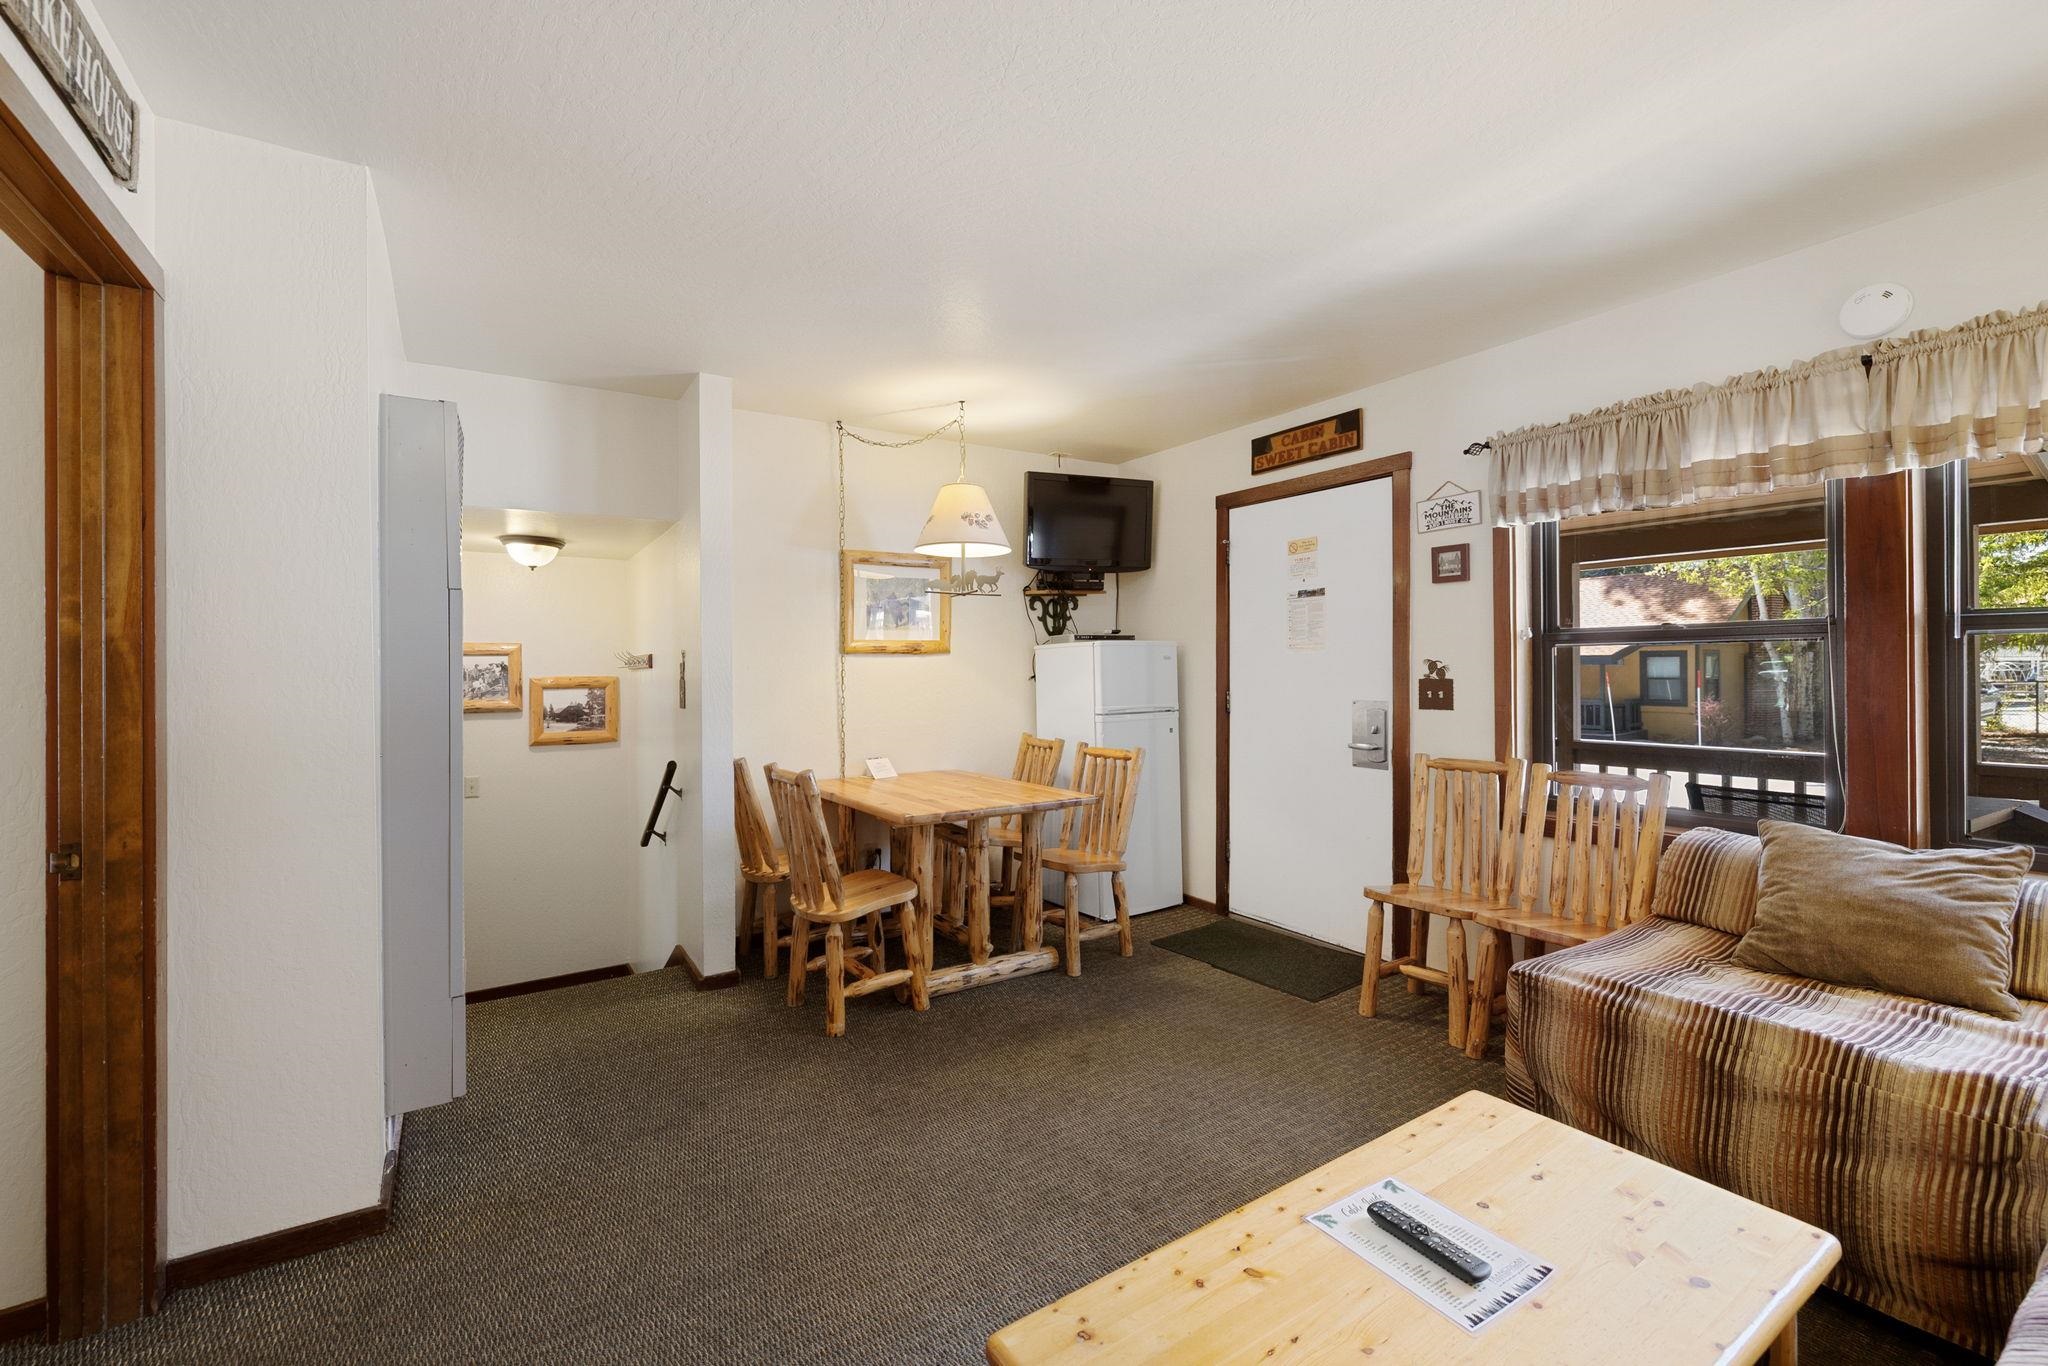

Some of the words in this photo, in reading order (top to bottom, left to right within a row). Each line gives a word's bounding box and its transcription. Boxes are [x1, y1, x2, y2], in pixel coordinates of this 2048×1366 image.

[22, 0, 72, 70] KE
[75, 28, 132, 167] HOUSE
[1281, 425, 1324, 447] CABIN
[1255, 445, 1305, 469] SWEET
[1308, 432, 1354, 455] CABIN
[1424, 506, 1472, 520] MOUNTAINS
[1440, 503, 1455, 511] THE
